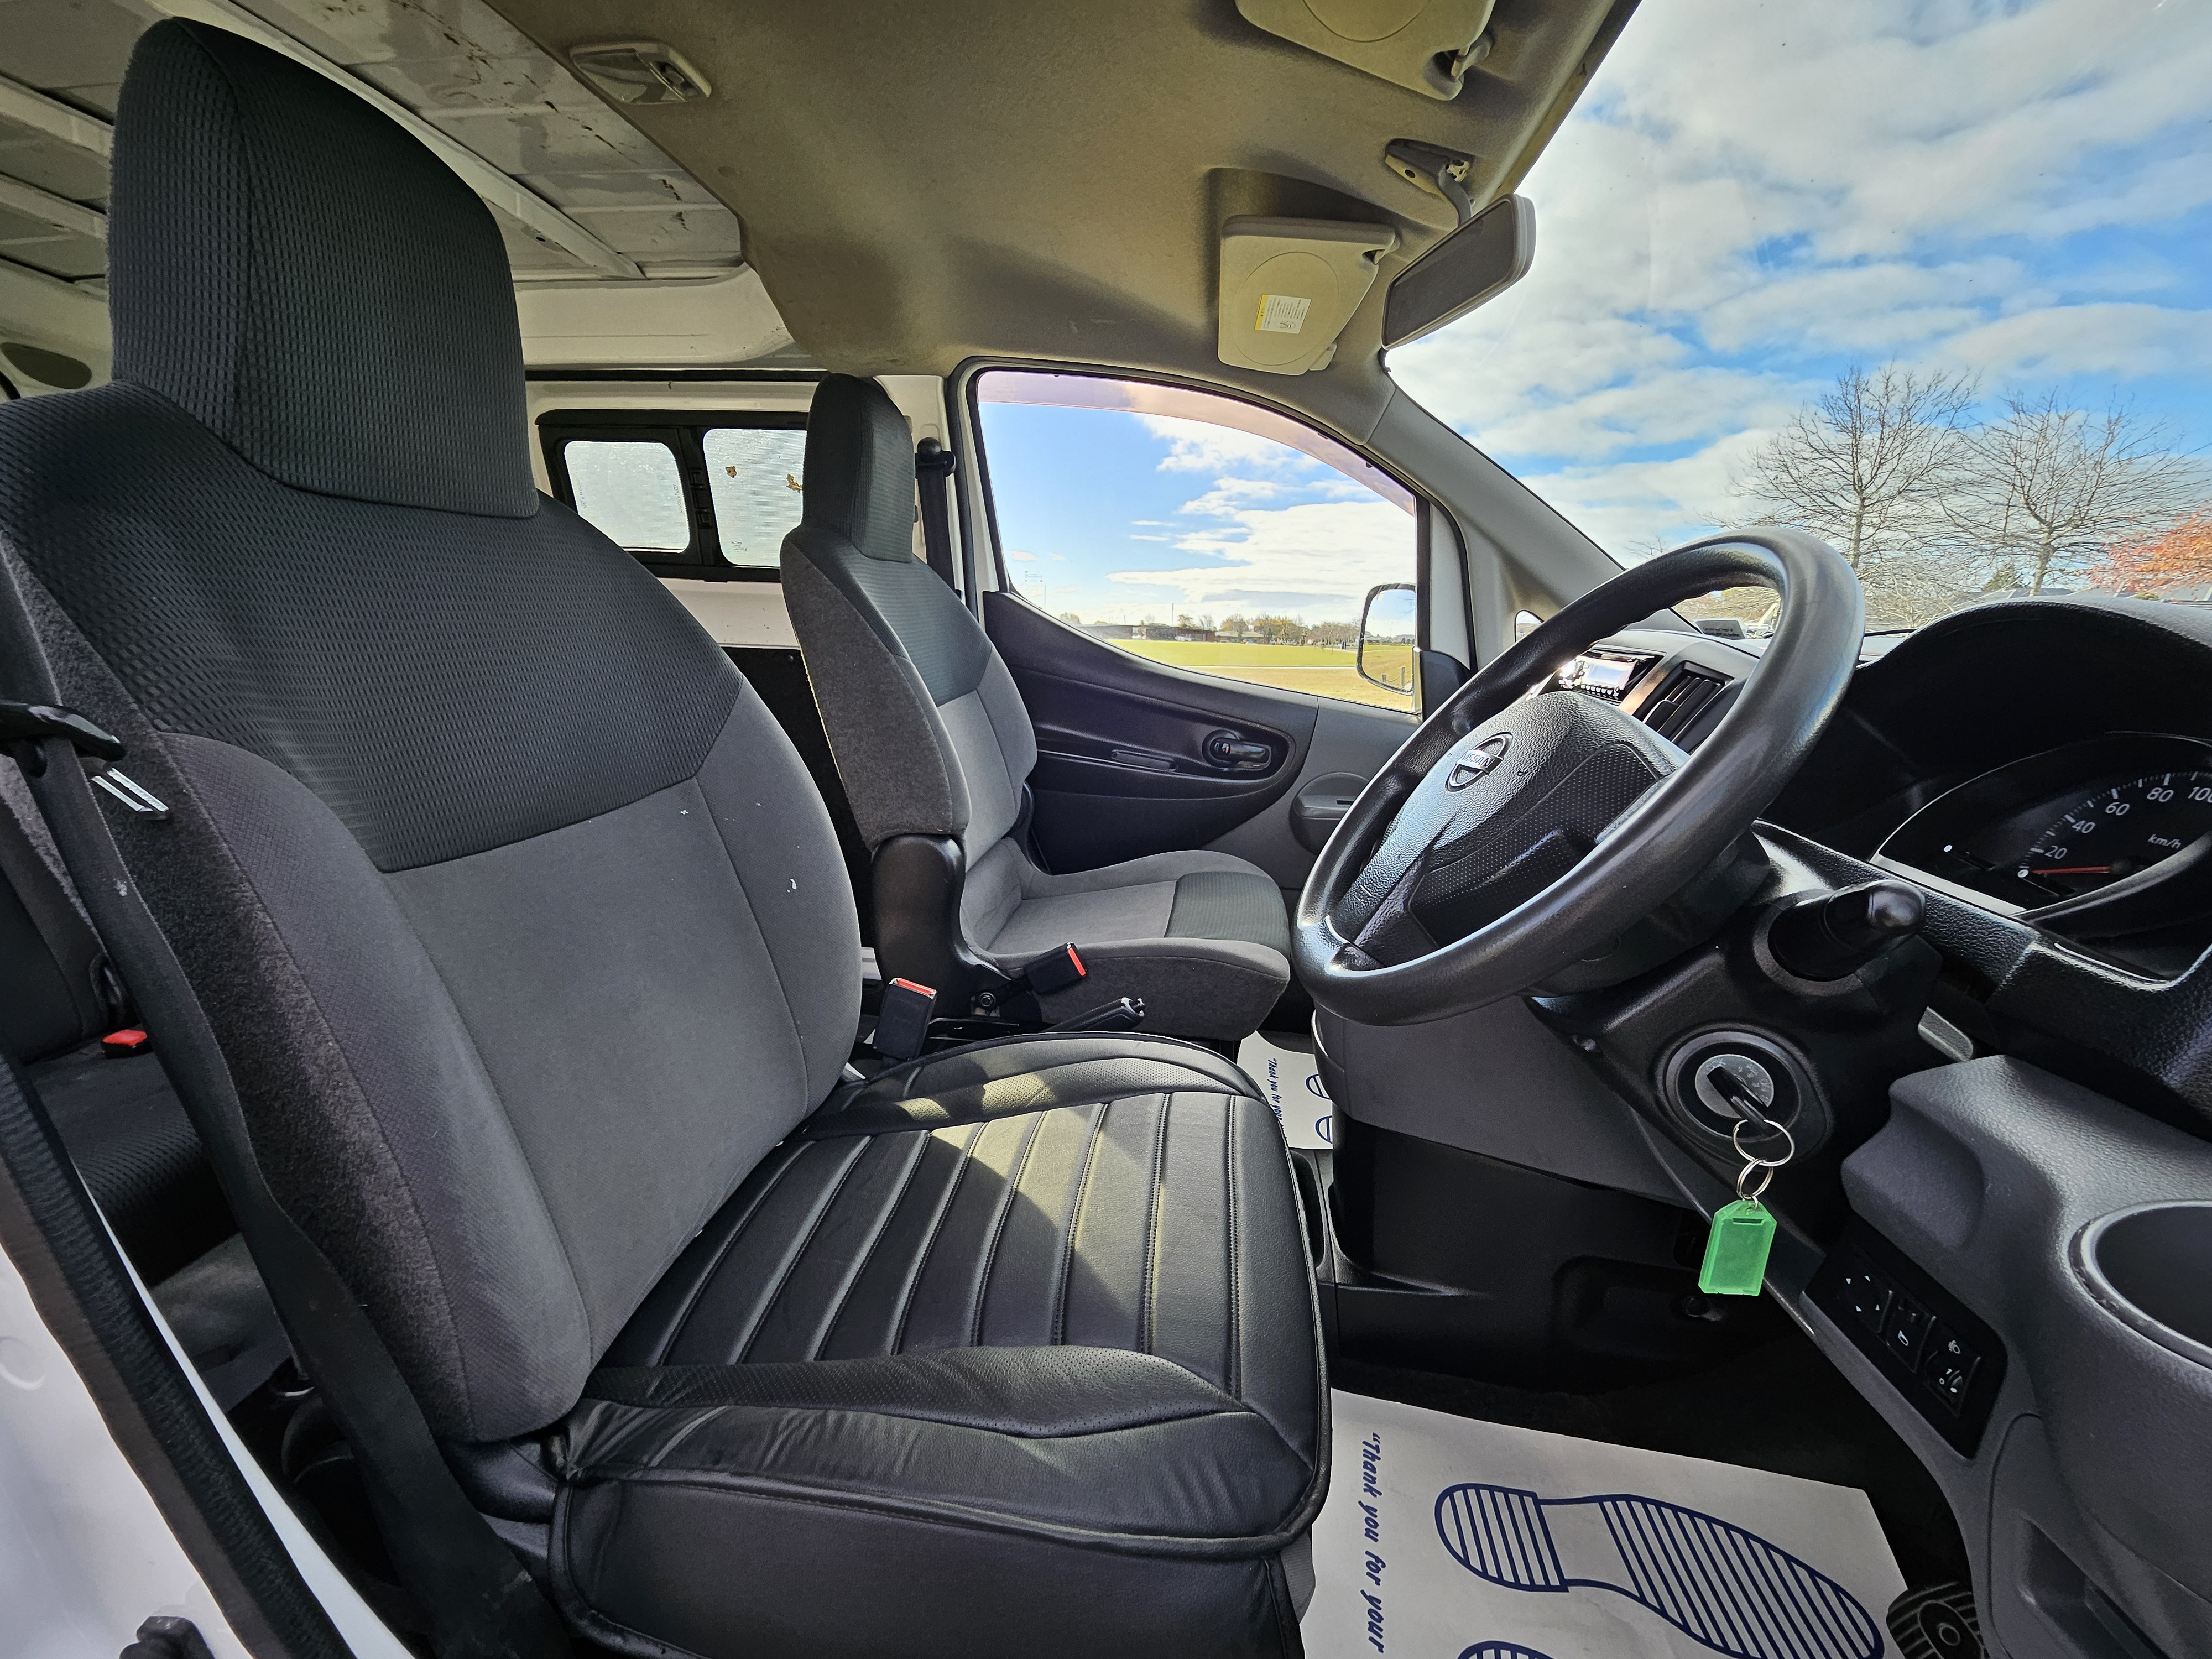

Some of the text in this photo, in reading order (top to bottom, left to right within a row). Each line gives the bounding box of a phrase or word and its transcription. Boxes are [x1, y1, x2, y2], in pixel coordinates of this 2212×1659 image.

[1462, 753, 1495, 769] NISSAN
[2147, 787, 2174, 802] 80
[2105, 802, 2130, 816] 60
[2072, 820, 2095, 833] 40
[2147, 834, 2182, 849] km/h
[2044, 845, 2068, 859] 20
[1266, 1079, 1279, 1092] you
[1271, 1093, 1282, 1103] for
[1358, 1432, 1386, 1653] “Thank you for your
